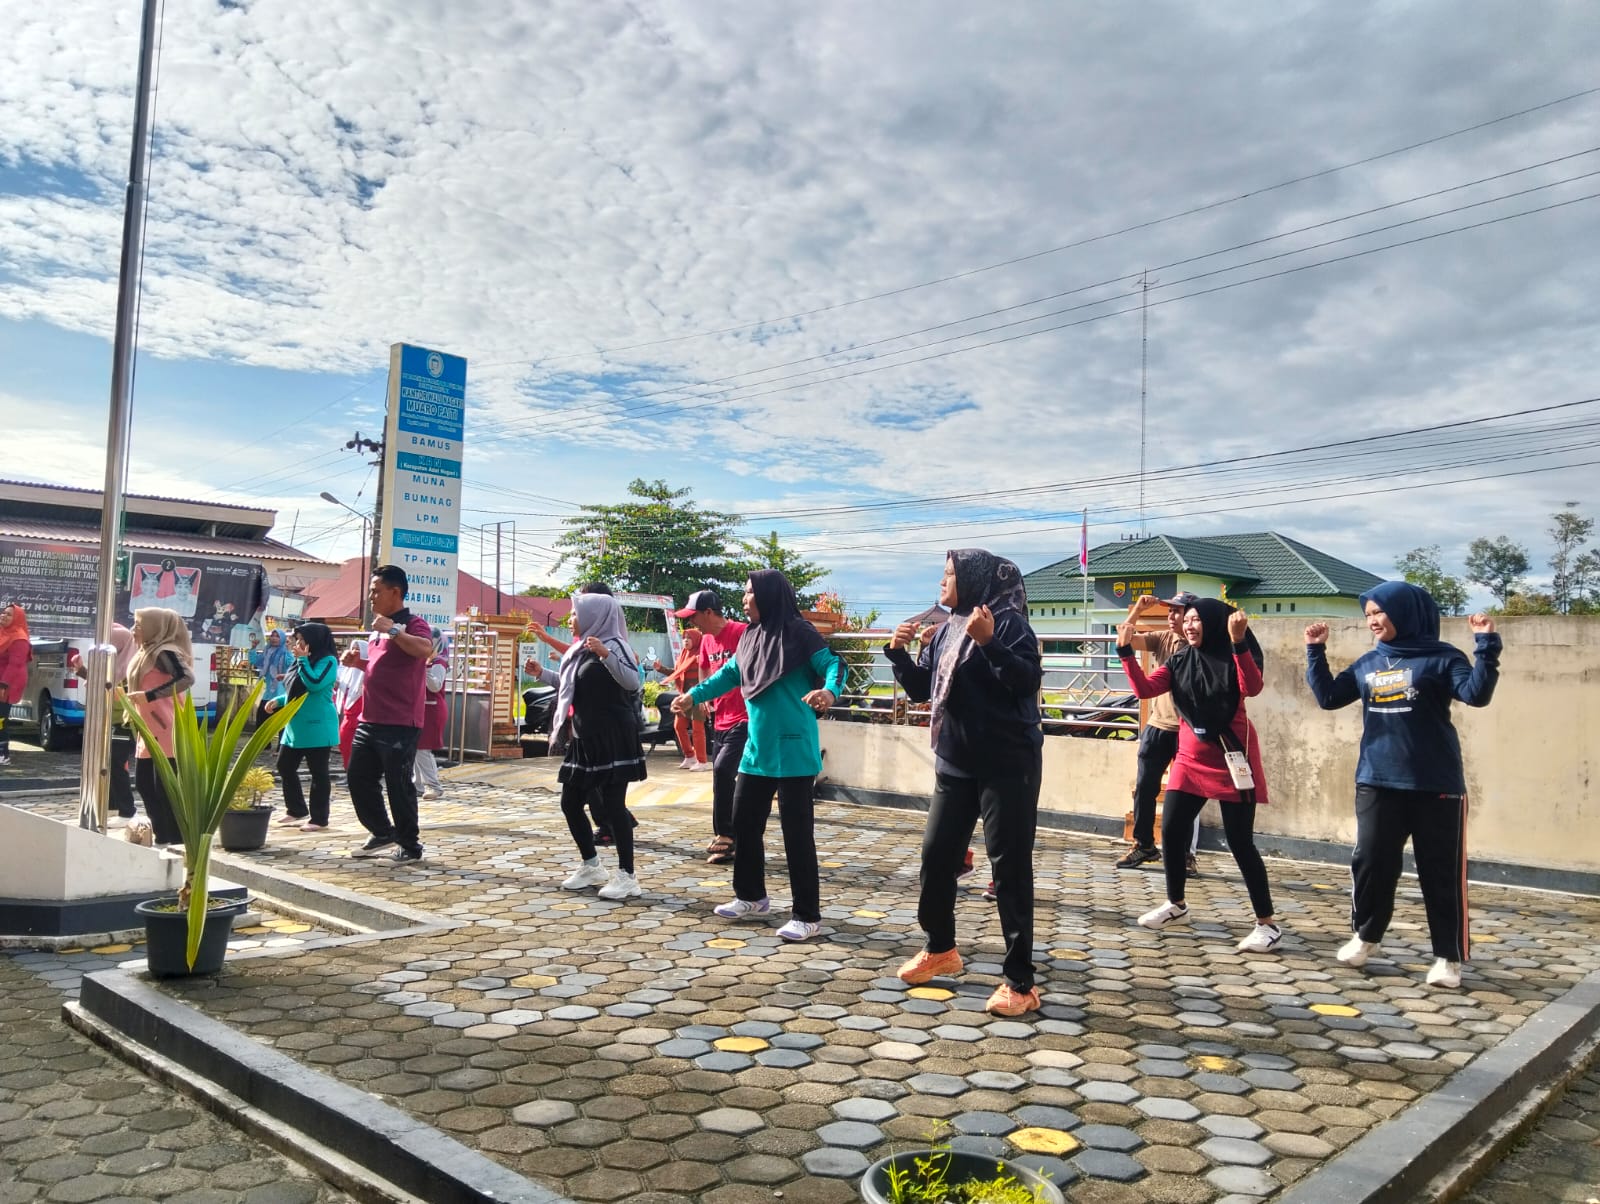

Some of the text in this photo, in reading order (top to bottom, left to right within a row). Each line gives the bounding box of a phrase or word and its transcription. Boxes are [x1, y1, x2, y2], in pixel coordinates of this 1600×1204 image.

[406, 399, 437, 416] MUARO
[412, 437, 450, 450] BAMUS
[412, 475, 445, 487] MUNA
[404, 493, 452, 507] BUMNAG
[416, 513, 439, 524] LPM
[15, 548, 41, 558] DAFTAR
[20, 558, 58, 568] GUBERNUR
[74, 562, 95, 571] WAKIL
[166, 561, 171, 569] 2
[20, 567, 58, 577] SUMATERA
[59, 569, 81, 578] BARAT
[404, 592, 441, 604] BABINSA
[22, 602, 32, 610] 27
[34, 603, 90, 614] NOVEMBER
[1376, 674, 1404, 686] KPPS
